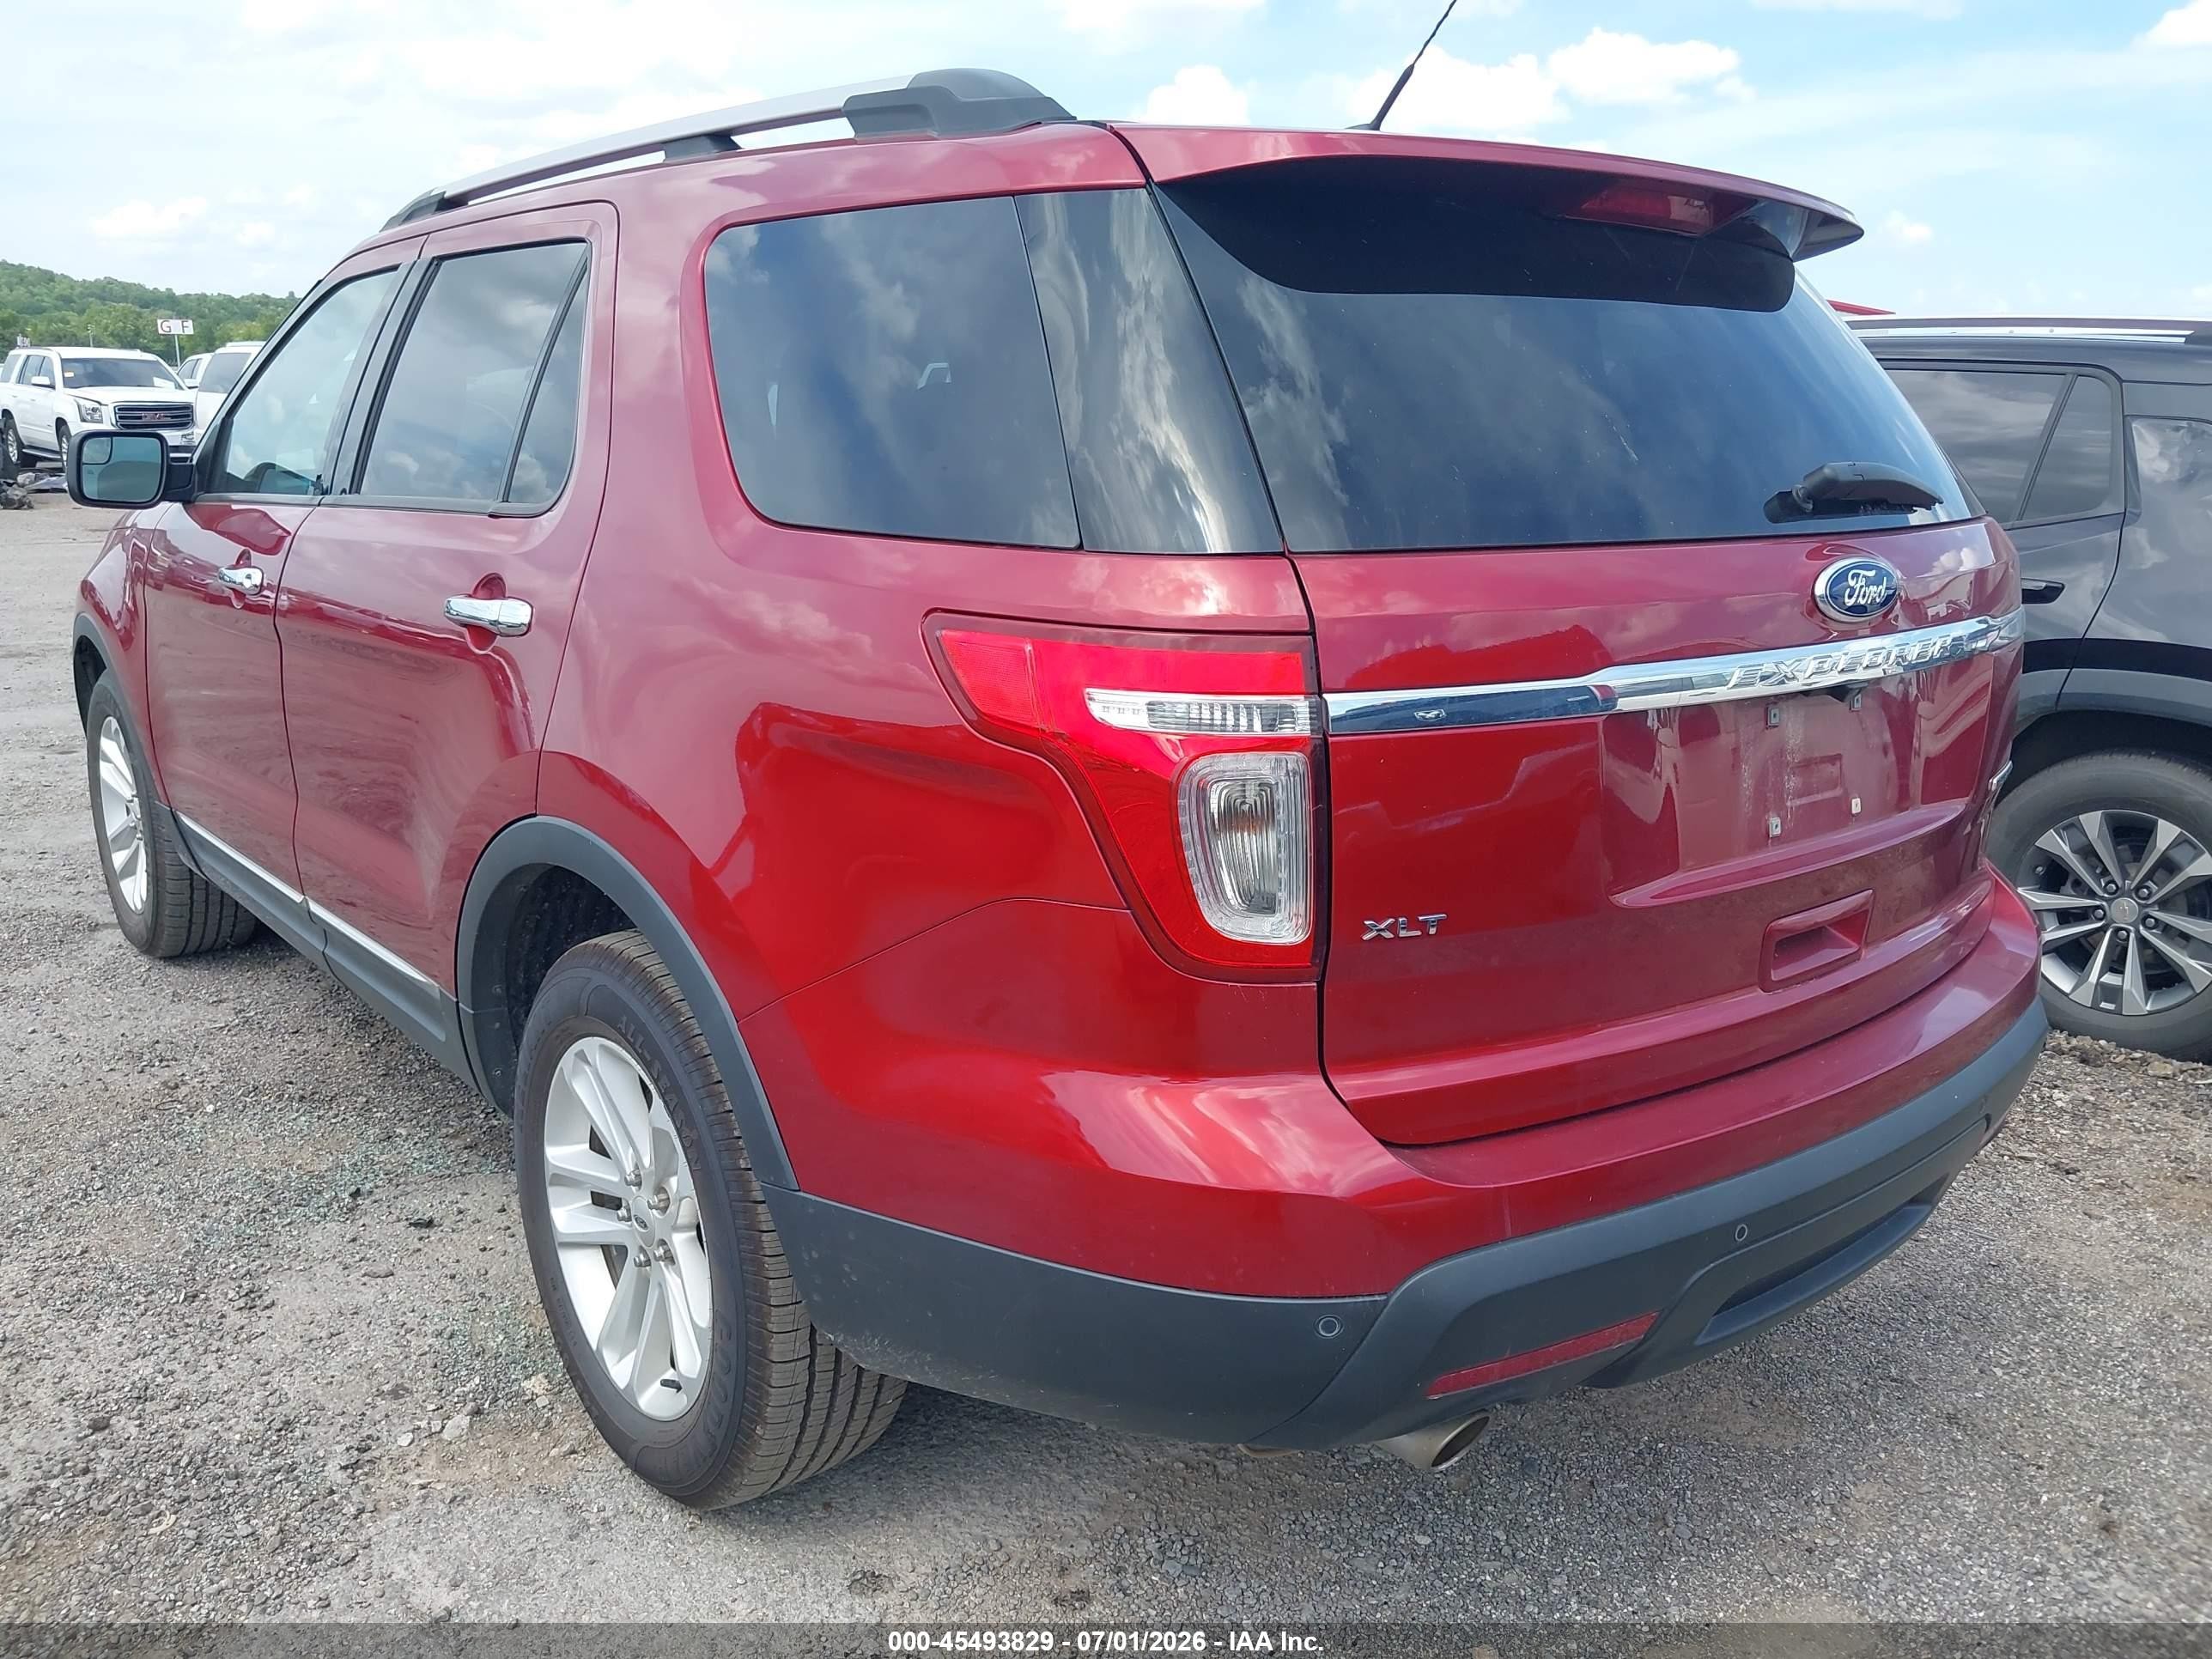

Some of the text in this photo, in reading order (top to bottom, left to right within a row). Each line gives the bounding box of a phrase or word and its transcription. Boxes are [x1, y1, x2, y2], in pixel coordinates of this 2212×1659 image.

[1844, 568, 1887, 606] Ford
[1726, 632, 1966, 690] EXPLORER
[1360, 914, 1448, 941] XLT
